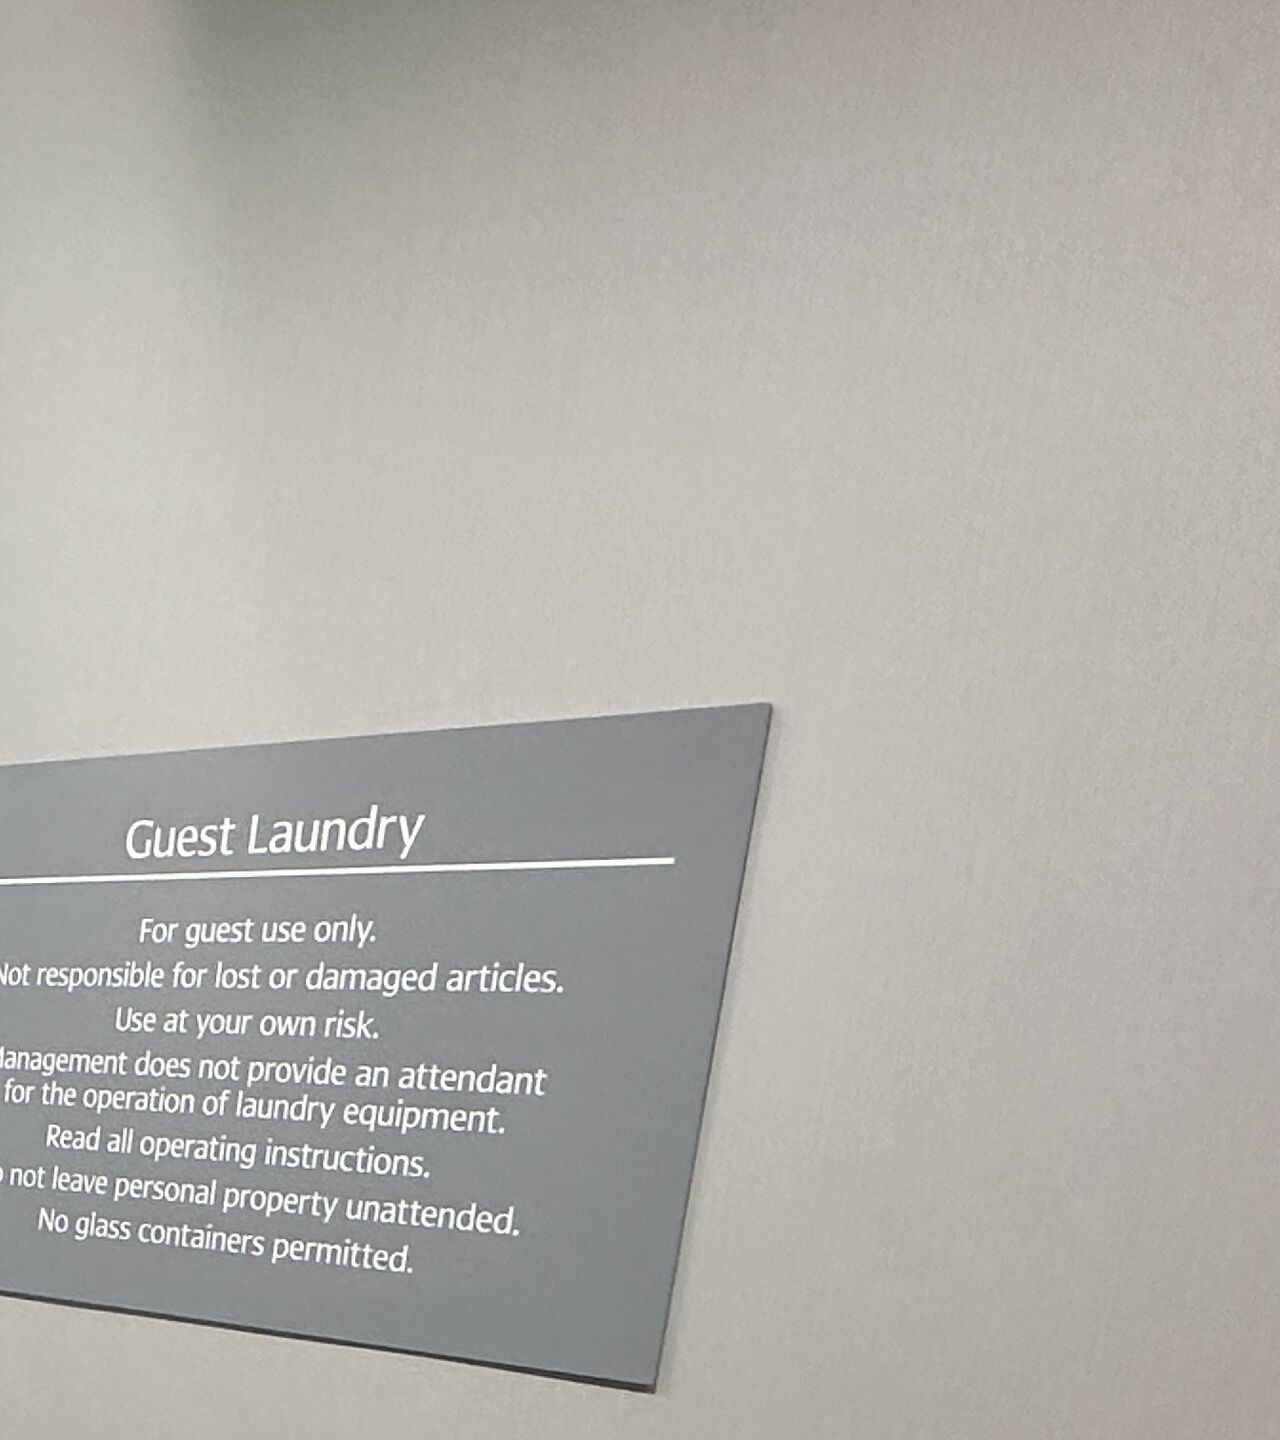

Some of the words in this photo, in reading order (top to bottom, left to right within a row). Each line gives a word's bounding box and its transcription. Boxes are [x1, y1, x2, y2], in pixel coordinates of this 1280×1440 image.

[126, 817, 236, 859] Guest
[247, 804, 426, 860] Laundry
[139, 918, 180, 944] For
[184, 918, 255, 949] guest
[261, 921, 307, 943] use
[313, 913, 376, 949] only.
[36, 960, 165, 993] responsible
[172, 960, 209, 989] for
[214, 960, 263, 990] lost
[268, 968, 299, 990] or
[305, 961, 439, 998] damaged
[446, 961, 564, 994] articles.
[115, 1006, 157, 1033] Use
[162, 1009, 190, 1034] at
[196, 1013, 254, 1040] your
[259, 1015, 317, 1037] own
[324, 1009, 379, 1040] risk.
[134, 1049, 192, 1078] does
[198, 1056, 241, 1082] not
[246, 1055, 347, 1088] provide
[354, 1065, 390, 1088] an
[398, 1063, 548, 1097] attendant
[4, 1077, 36, 1104] for
[41, 1080, 77, 1107] the
[82, 1085, 196, 1115] operation
[202, 1089, 232, 1116] of
[235, 1089, 337, 1130] laundry
[343, 1098, 505, 1135] equipment.
[46, 1124, 101, 1152] Read
[106, 1127, 135, 1154] all
[139, 1134, 257, 1170] operating
[264, 1137, 430, 1179] instructions.
[9, 1166, 46, 1189] not
[51, 1165, 109, 1195] leave
[113, 1177, 217, 1206] personal
[222, 1187, 339, 1224] property
[345, 1198, 520, 1237] unattended.
[37, 1207, 69, 1233] No
[74, 1211, 132, 1241] glass
[137, 1223, 265, 1257] containers
[271, 1238, 413, 1274] permitted.
